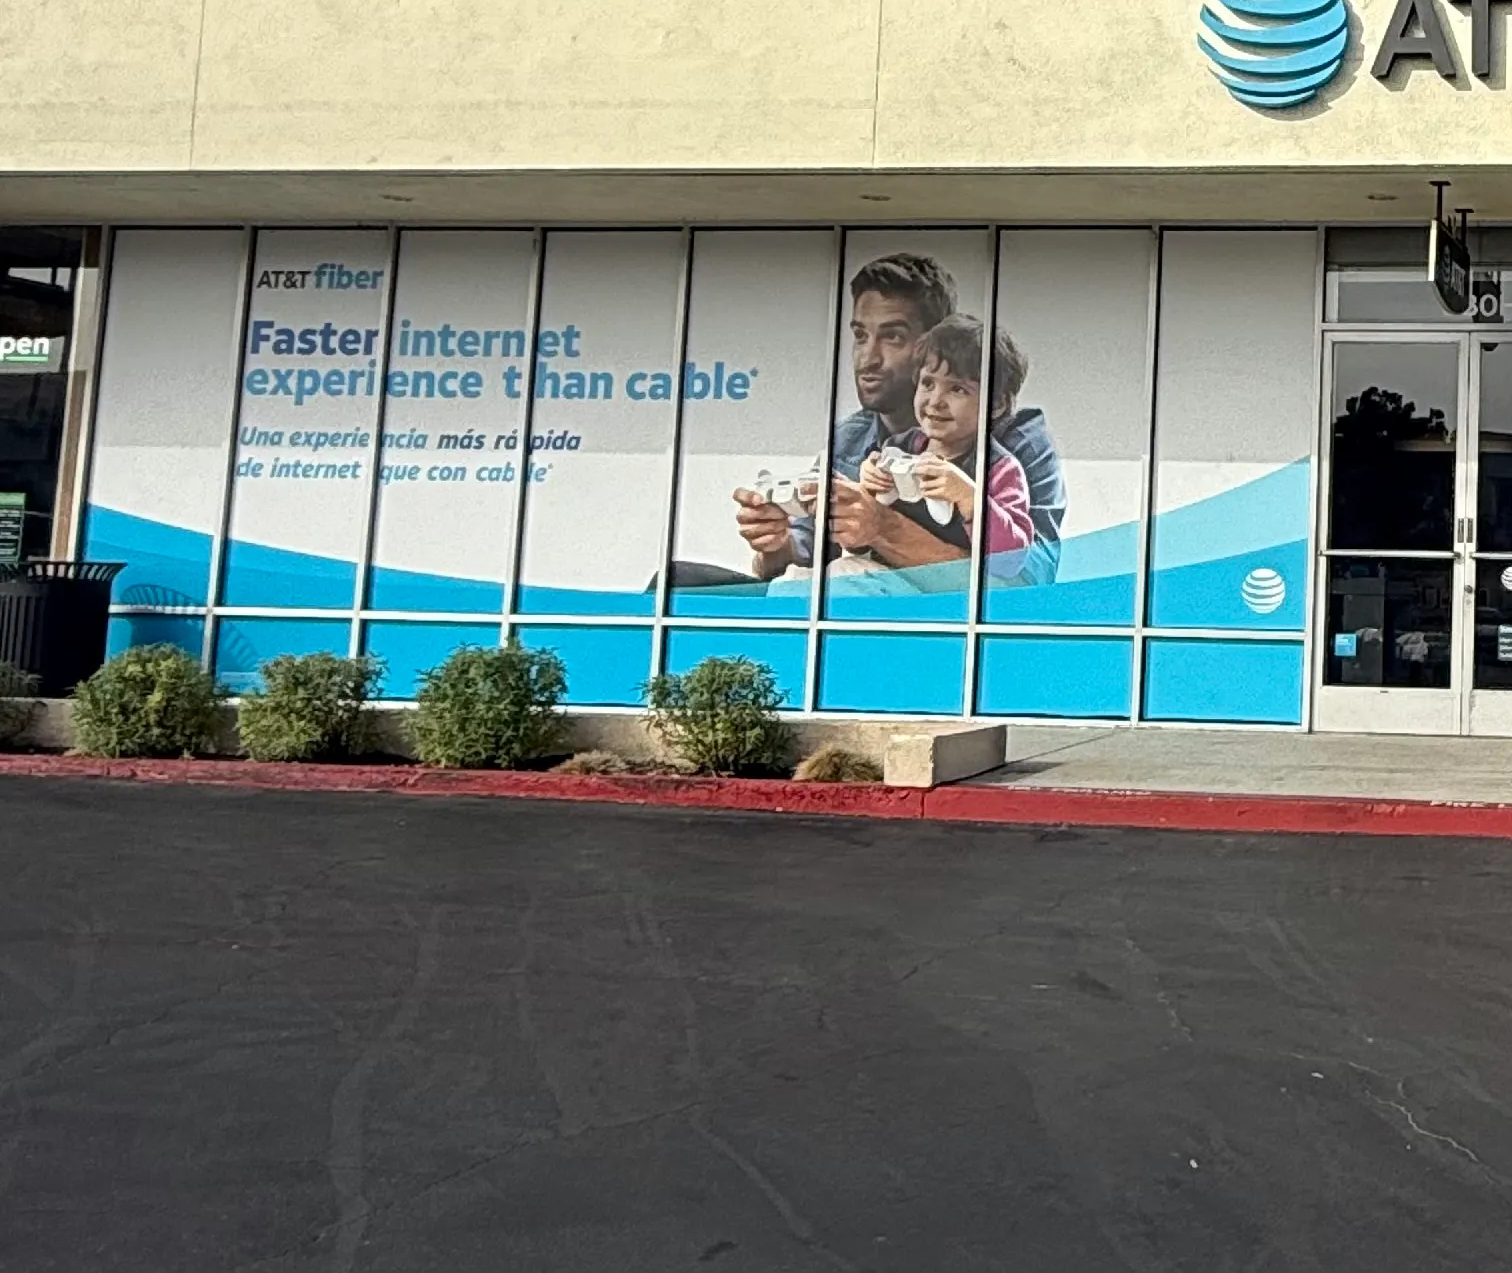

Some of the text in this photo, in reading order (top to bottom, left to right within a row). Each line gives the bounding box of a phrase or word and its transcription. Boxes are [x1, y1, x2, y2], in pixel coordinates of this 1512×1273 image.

[256, 263, 384, 289] AT&T fiber
[250, 319, 581, 358] Faster internet
[246, 359, 484, 406] experience
[503, 362, 614, 400] than
[240, 427, 582, 452] Una experiencia más rápida
[236, 457, 263, 478] de
[270, 457, 362, 479] internet
[379, 465, 421, 485] que
[427, 465, 467, 482] con
